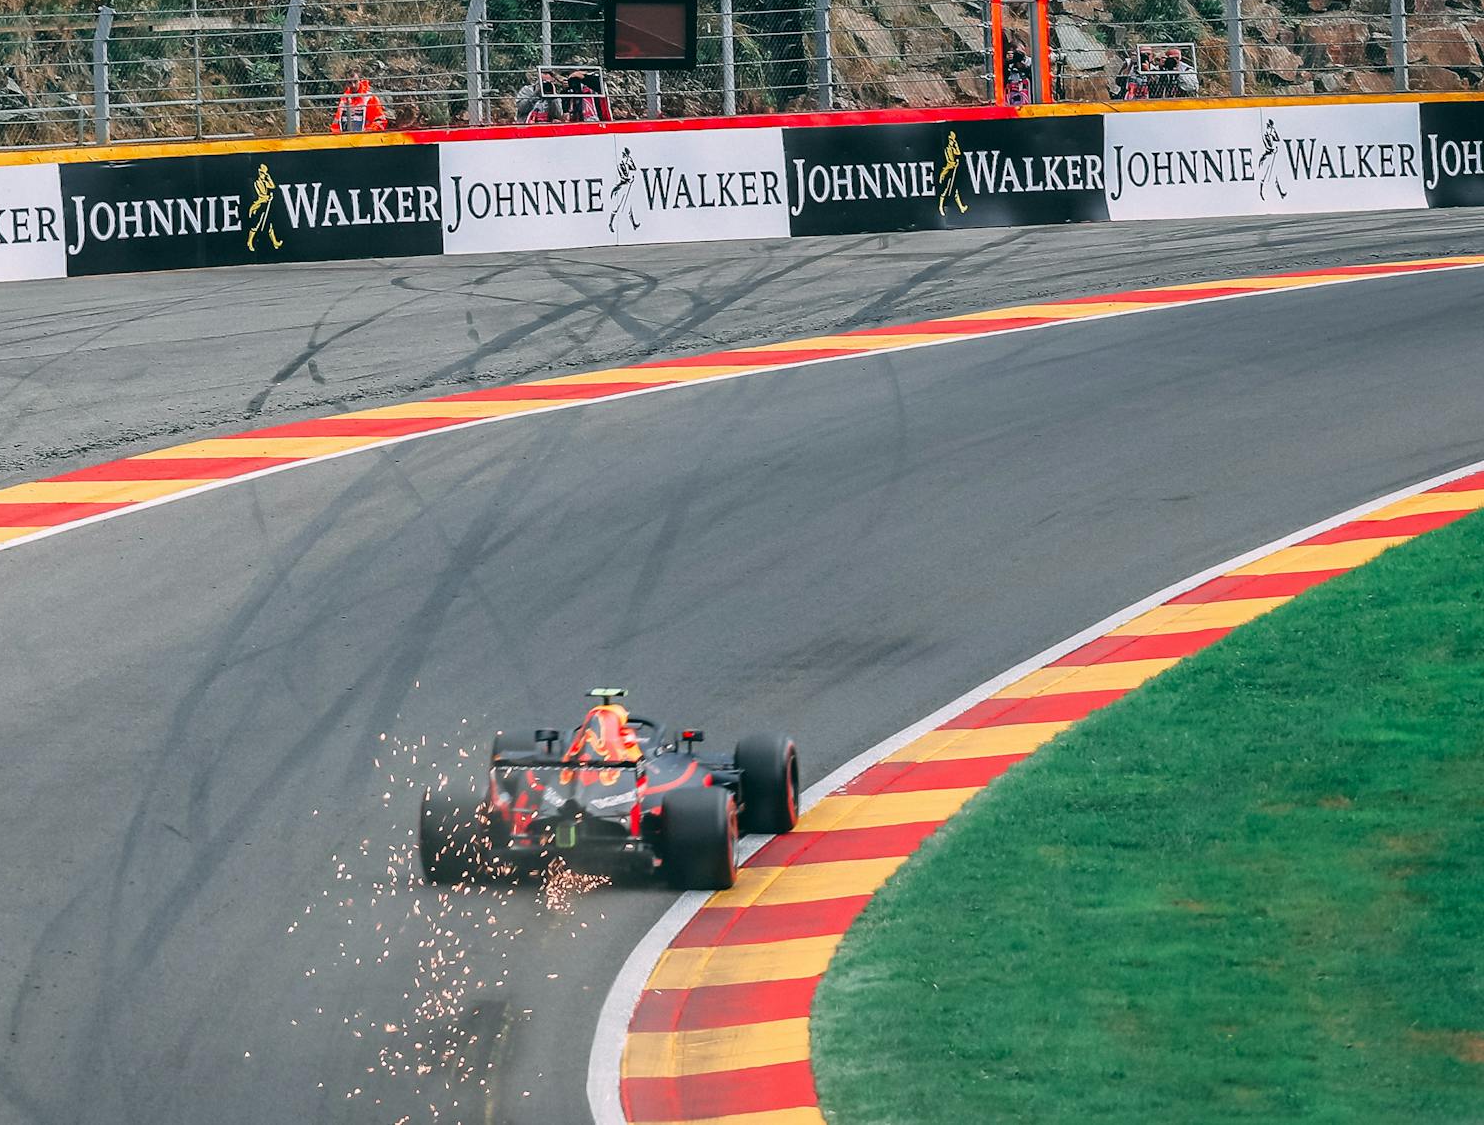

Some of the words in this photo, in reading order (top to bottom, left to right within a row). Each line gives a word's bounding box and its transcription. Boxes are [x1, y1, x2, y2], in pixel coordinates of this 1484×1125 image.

[447, 176, 604, 233] JOHNNIE
[640, 166, 782, 210] WALKER
[791, 158, 937, 217] JOHNNIE
[963, 150, 1105, 194] WALKER
[1110, 145, 1255, 201] JOHNNIE
[1283, 138, 1418, 180] WALKER
[68, 195, 242, 256] JOHNNIE
[279, 182, 441, 229] WALKER
